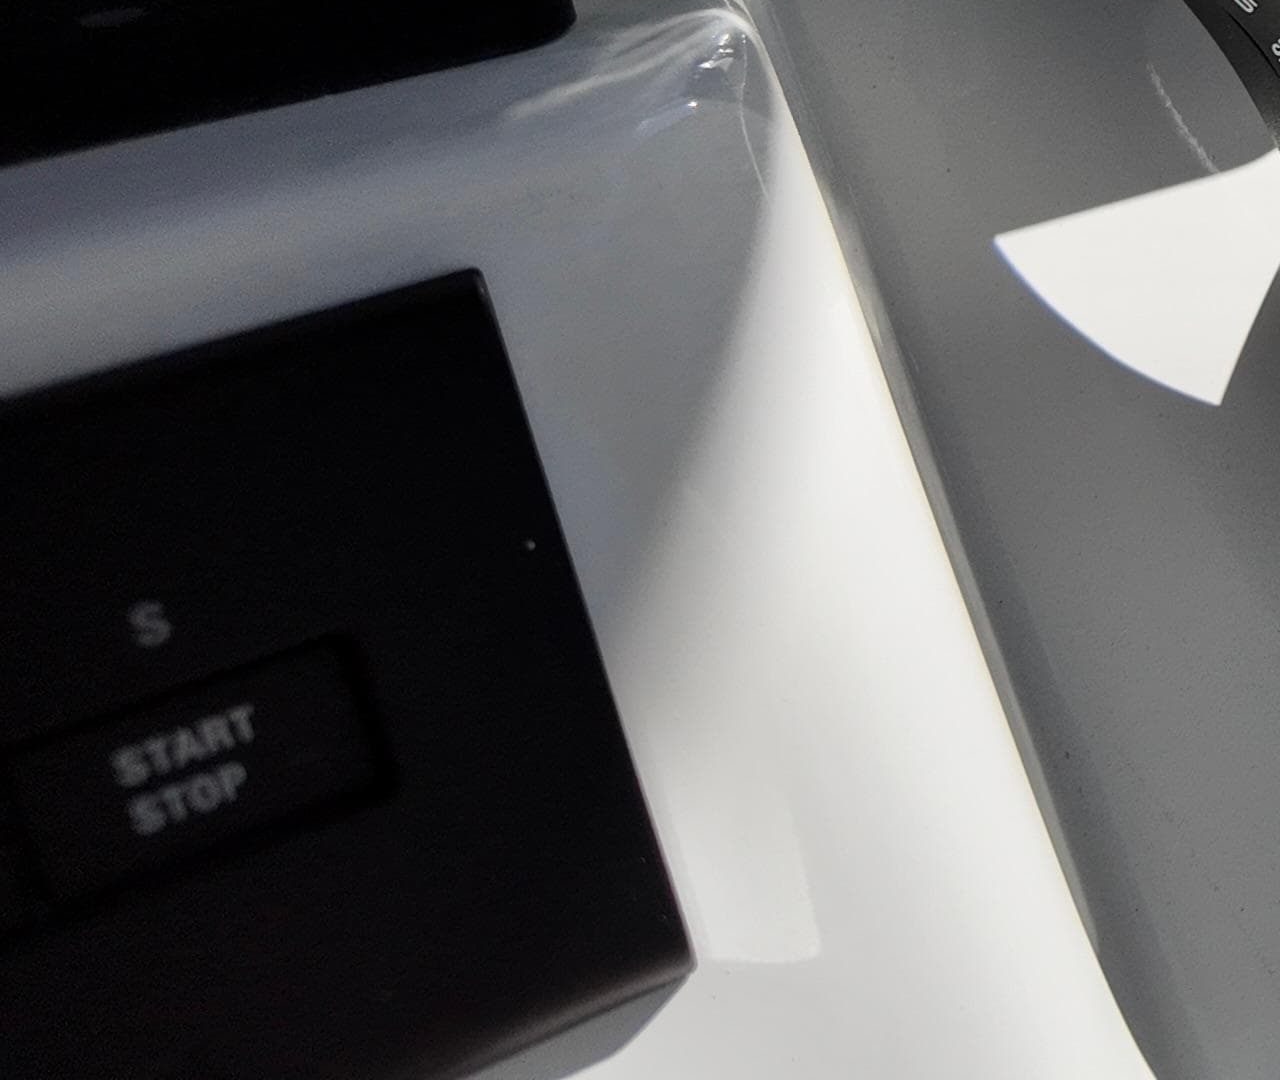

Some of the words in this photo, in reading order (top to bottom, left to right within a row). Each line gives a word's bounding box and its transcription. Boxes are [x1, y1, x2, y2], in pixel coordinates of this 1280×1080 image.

[128, 599, 173, 648] S
[110, 704, 255, 788] START
[127, 760, 248, 835] STOP
